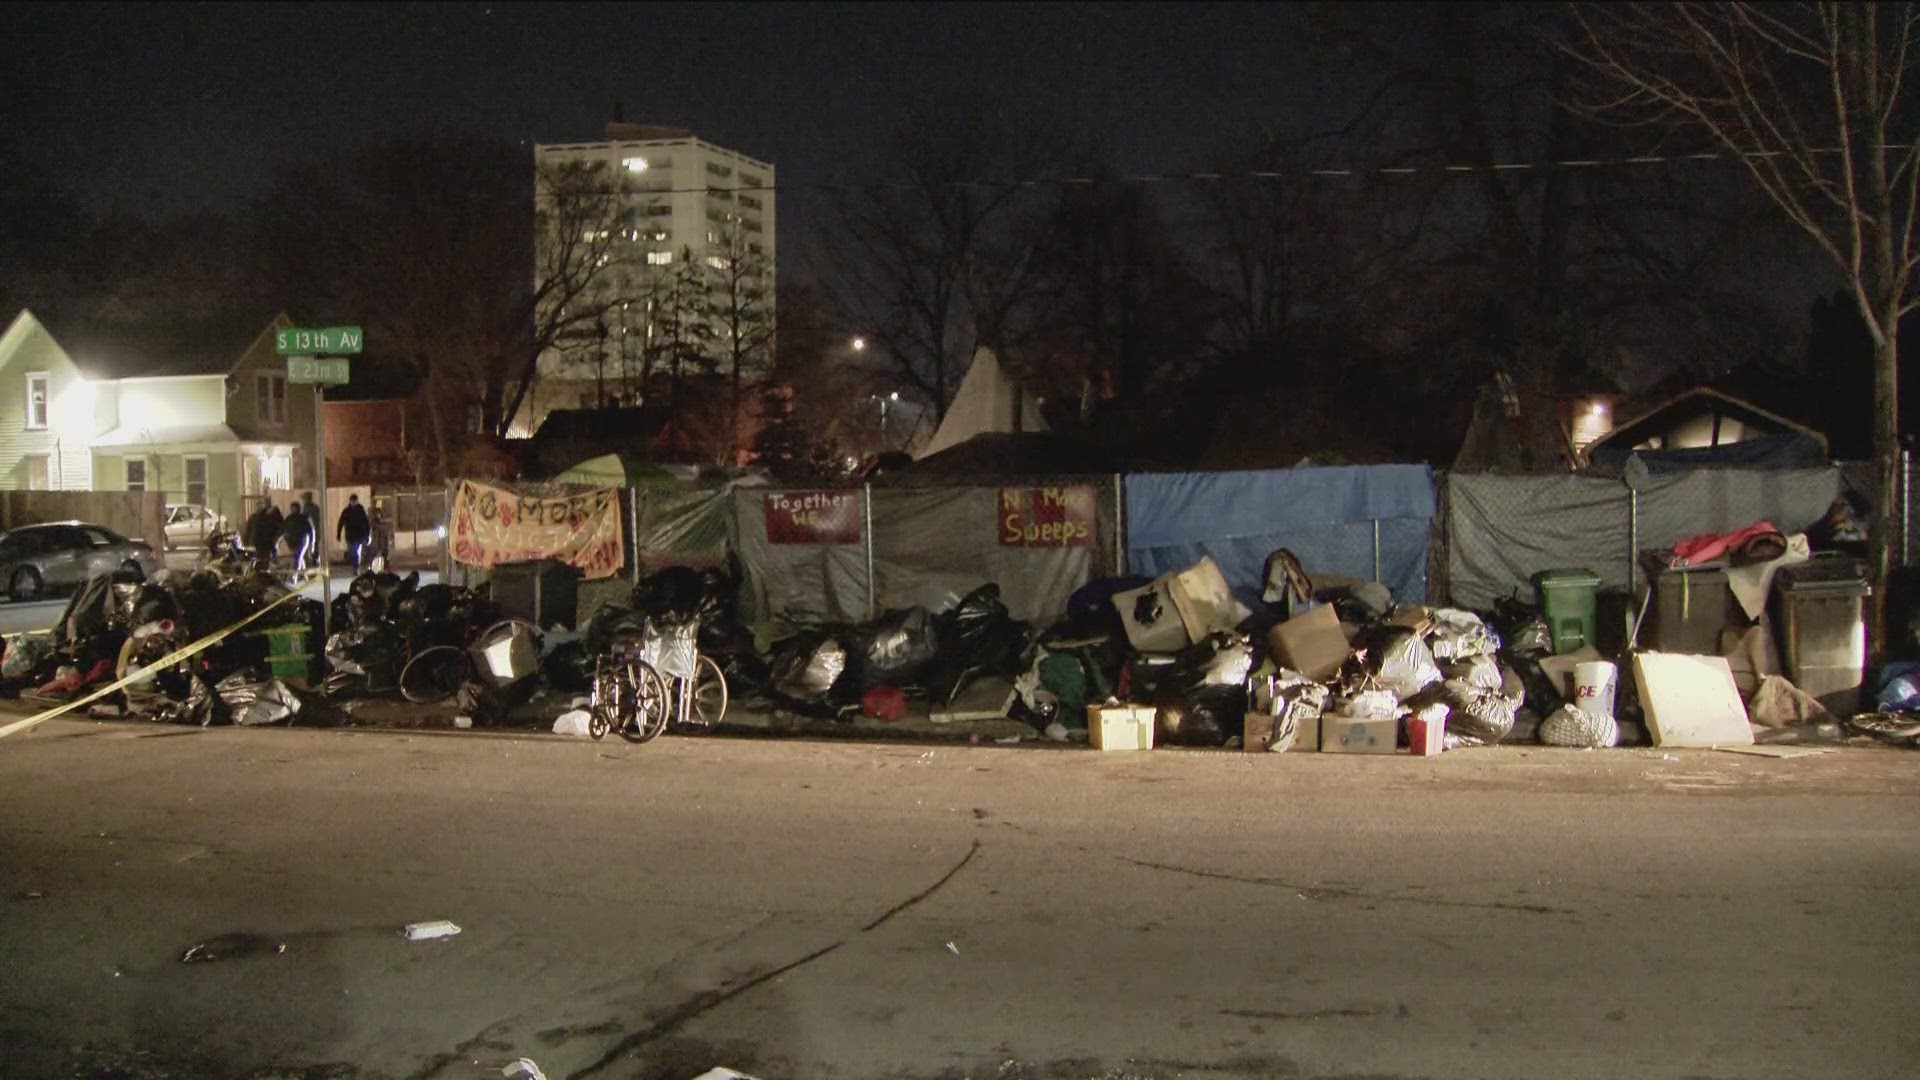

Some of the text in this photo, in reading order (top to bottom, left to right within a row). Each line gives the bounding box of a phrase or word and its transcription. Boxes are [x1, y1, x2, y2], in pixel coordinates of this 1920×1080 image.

[279, 331, 359, 349] S 13th Av
[768, 493, 854, 512] Together
[1005, 514, 1089, 545] Sweeps
